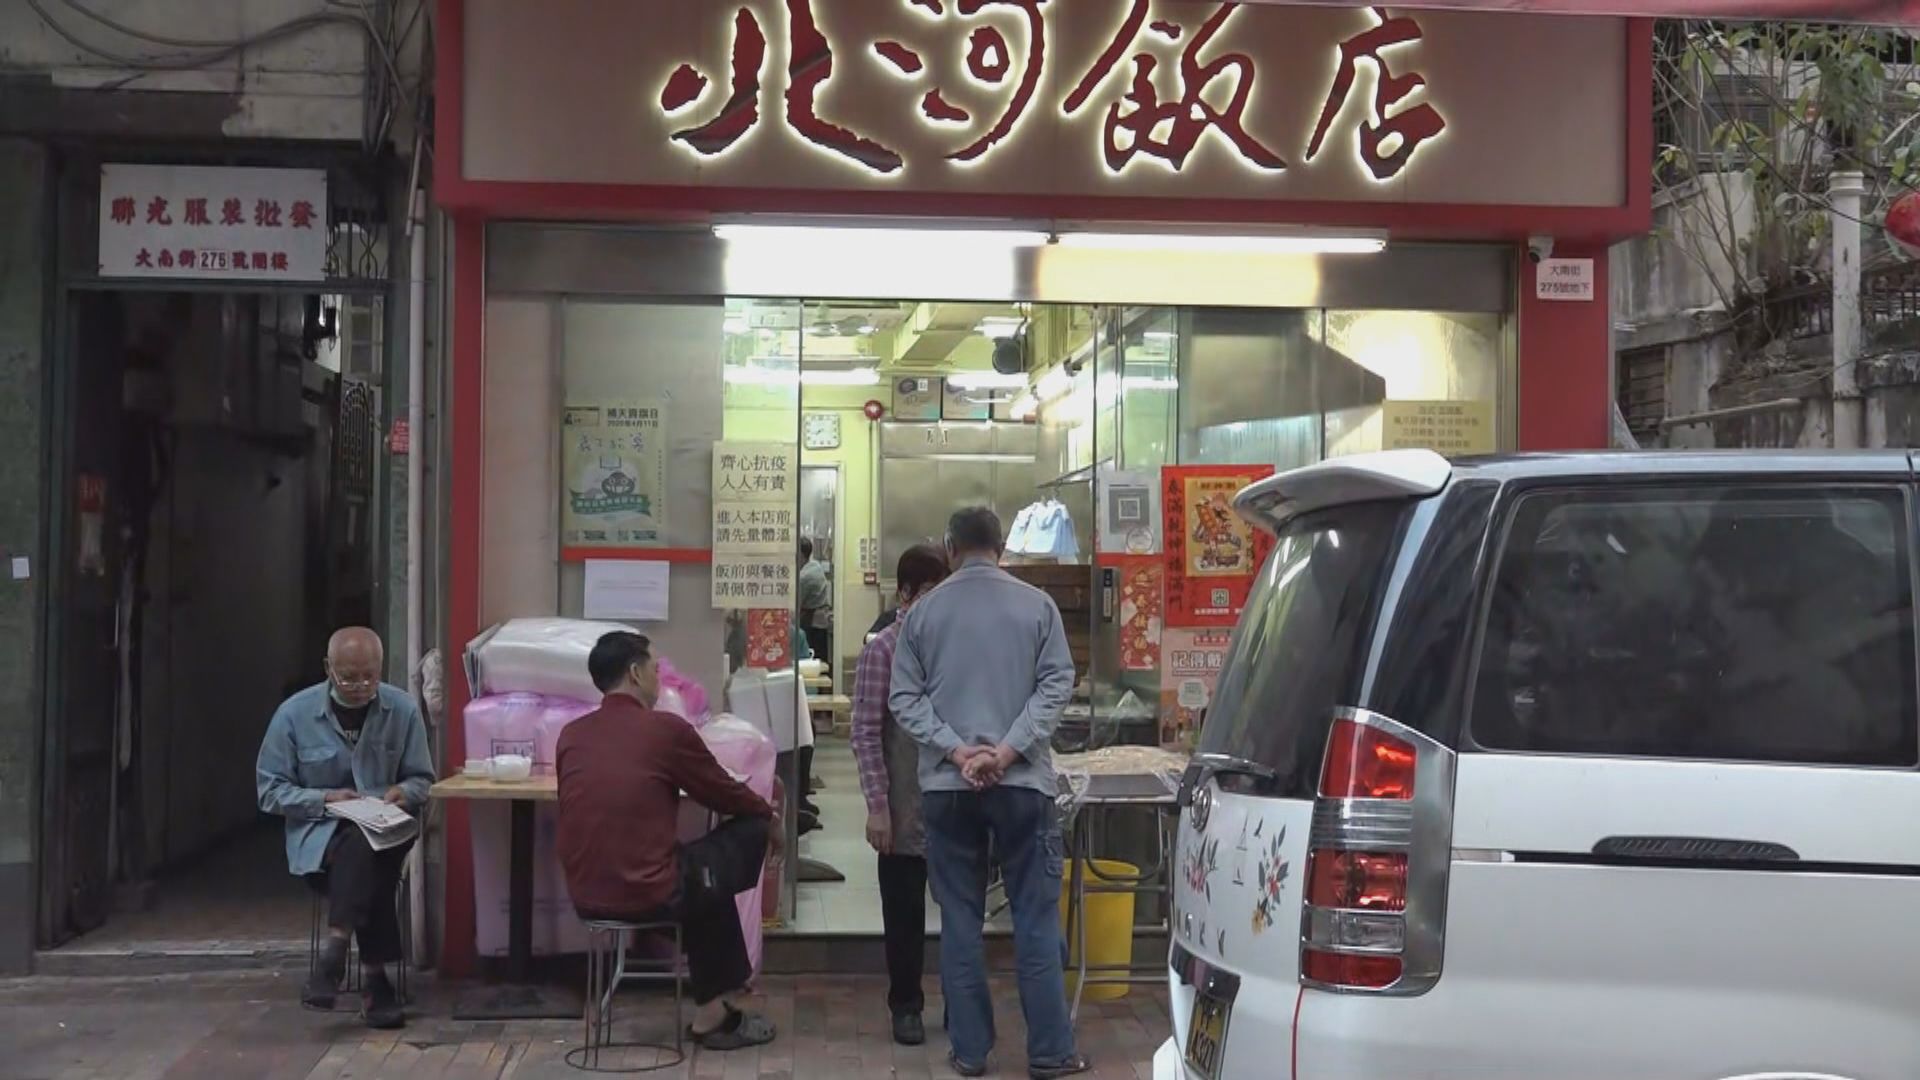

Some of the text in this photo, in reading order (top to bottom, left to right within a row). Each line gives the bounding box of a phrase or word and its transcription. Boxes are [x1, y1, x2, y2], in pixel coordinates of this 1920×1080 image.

[111, 195, 318, 230] 聯光服裝批發
[1550, 265, 1581, 276] 大南街
[1540, 282, 1591, 293] 275號地下
[721, 455, 787, 472] 齊心抗疫
[721, 474, 787, 491] 人人有責
[716, 528, 791, 543] 請先量體溫
[715, 564, 790, 579] 飯前與餐後
